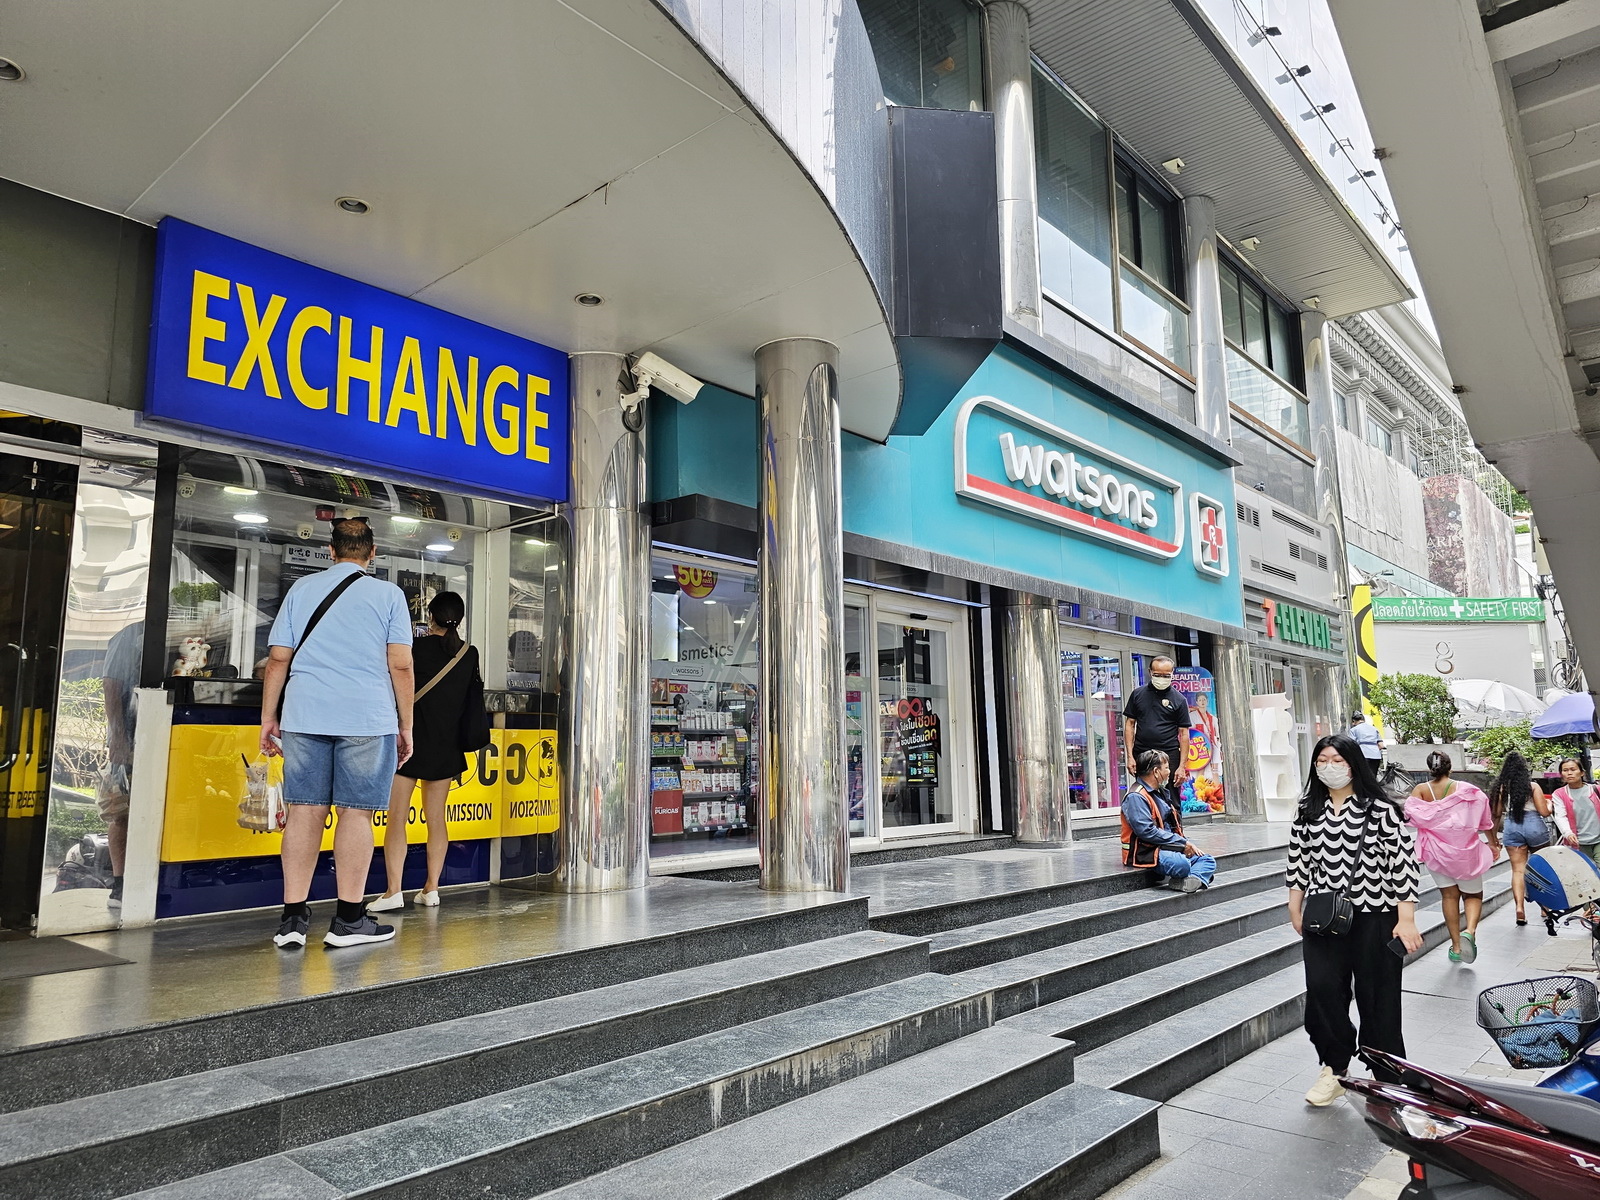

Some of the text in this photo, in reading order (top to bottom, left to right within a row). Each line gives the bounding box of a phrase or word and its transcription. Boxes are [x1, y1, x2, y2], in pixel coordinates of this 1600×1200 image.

[187, 269, 551, 464] EXCHANGE
[999, 432, 1158, 529] watsons
[1466, 601, 1542, 617] SAFETY FIRST
[680, 643, 734, 661] smetics
[675, 667, 700, 675] watsons
[1171, 673, 1200, 681] BEAUTY
[1171, 678, 1212, 692] OMB!!
[1187, 742, 1208, 762] 0%
